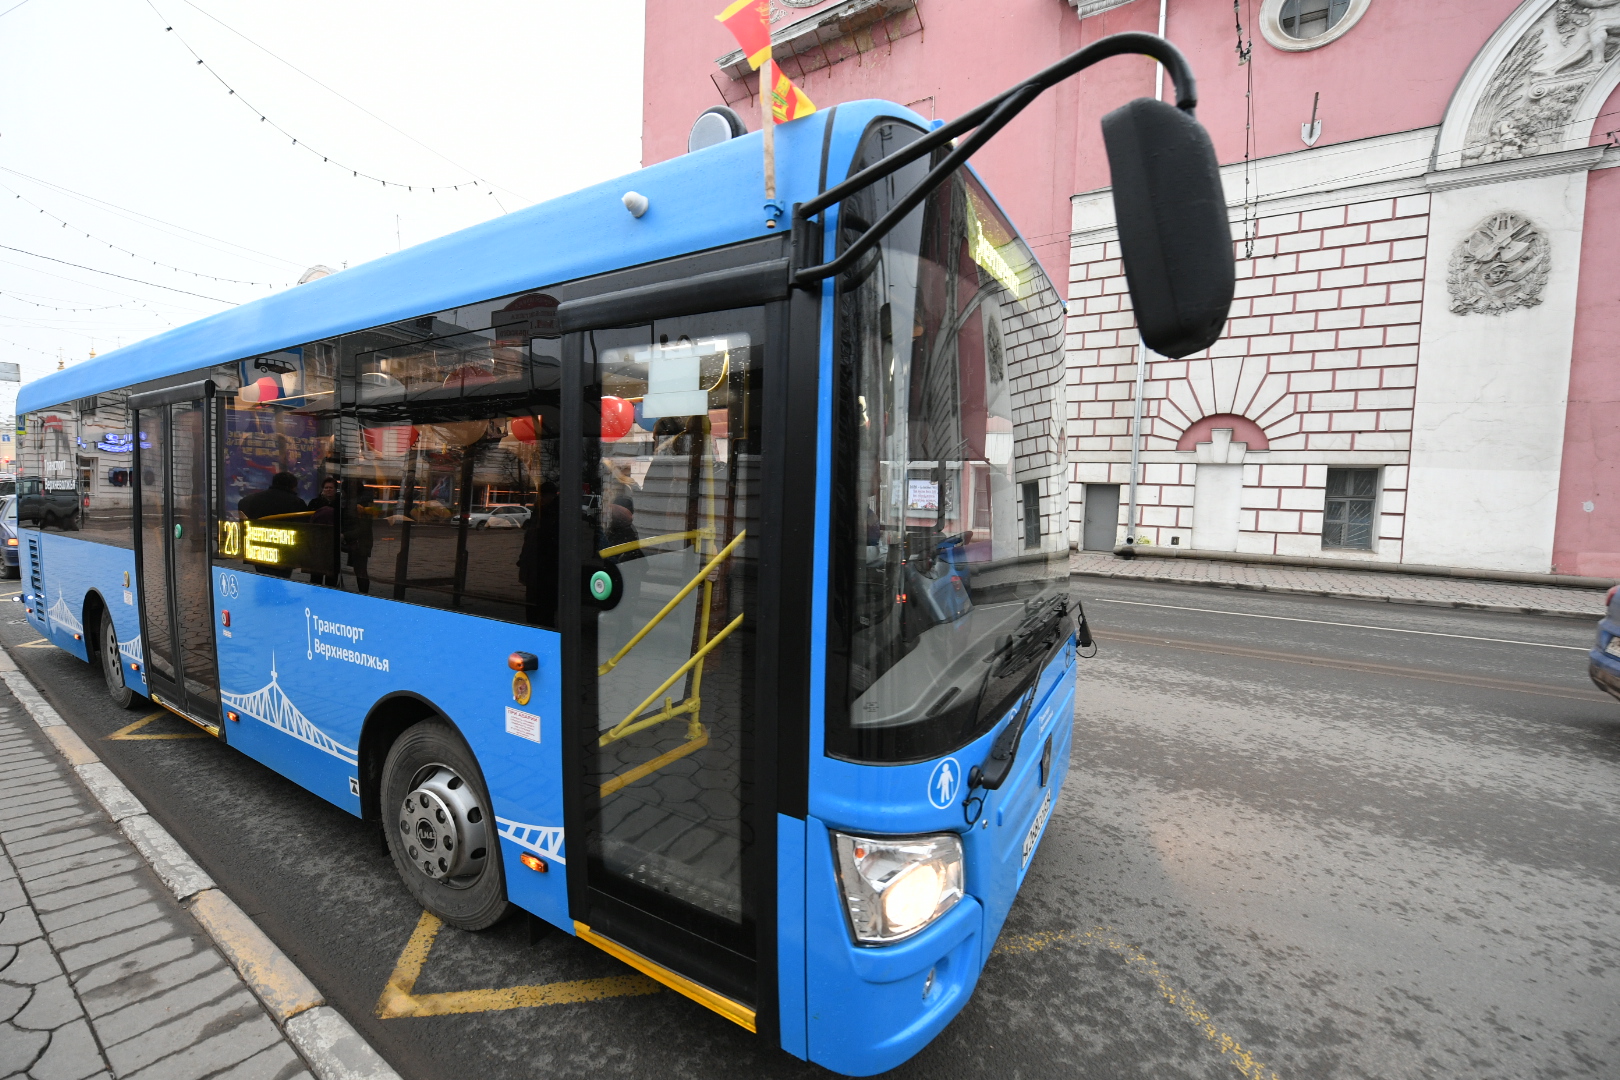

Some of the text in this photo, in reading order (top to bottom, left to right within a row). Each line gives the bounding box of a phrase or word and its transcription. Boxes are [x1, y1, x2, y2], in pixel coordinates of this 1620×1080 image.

[224, 521, 239, 556] 20
[312, 614, 365, 644] Транспорт
[314, 638, 390, 673] Верхневолжья
